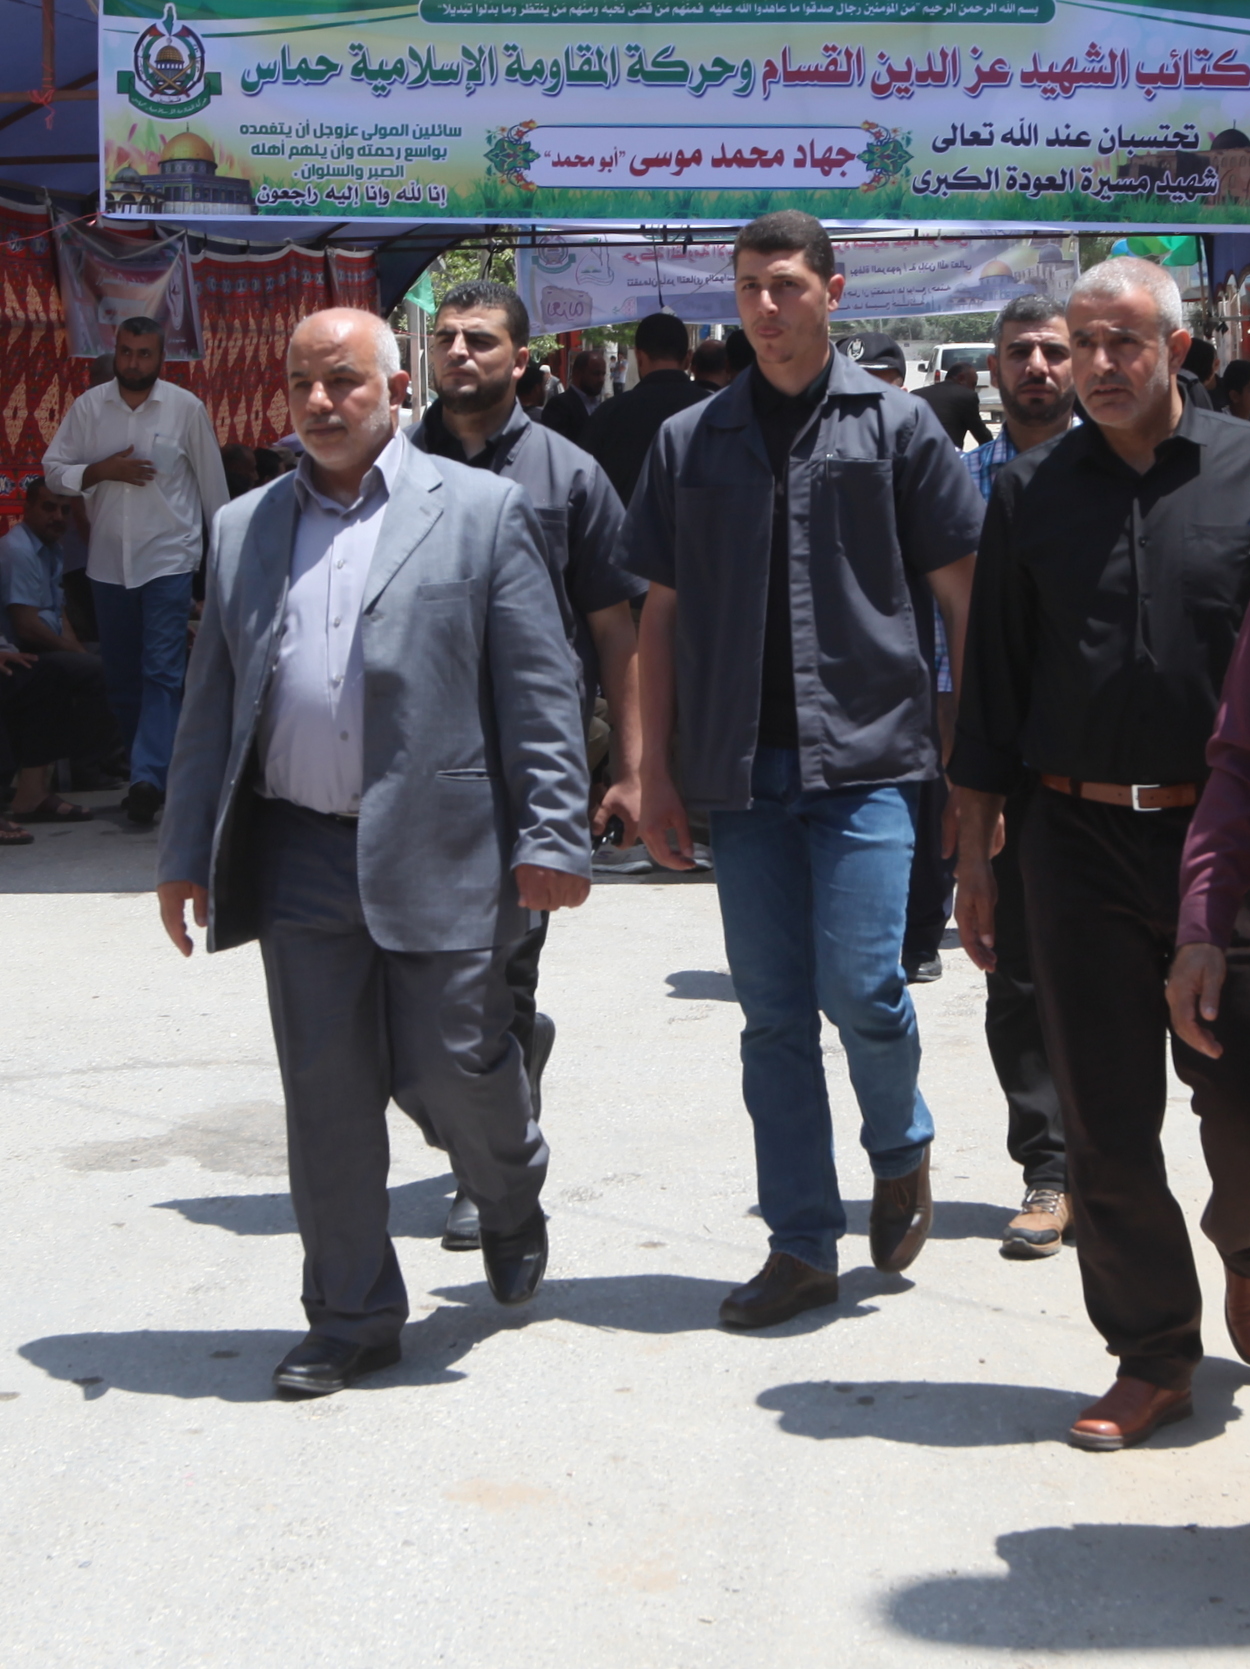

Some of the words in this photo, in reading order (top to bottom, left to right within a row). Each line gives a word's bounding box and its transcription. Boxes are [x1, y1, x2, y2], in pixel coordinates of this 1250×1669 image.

[922, 3, 957, 16] الرحيم
[958, 3, 997, 16] الرحمن
[1000, 2, 1016, 14] الله
[1017, 5, 1039, 17] بسم
[240, 43, 342, 97] حماس
[348, 41, 497, 97] الإسلامية
[501, 42, 619, 96] المقاومة
[623, 42, 755, 96] وحركة
[762, 42, 865, 100] القسام
[870, 45, 961, 99] الدين
[963, 44, 1012, 97] عز
[1019, 41, 1129, 98] الشهيد
[239, 121, 293, 137] يتغمده
[295, 119, 310, 139] أن
[313, 122, 359, 140] عزوجل
[361, 123, 410, 141] المولى
[412, 123, 463, 141] سائلين
[931, 120, 995, 153] تعالى
[1000, 117, 1039, 148] الله
[1044, 121, 1093, 149] عند
[1097, 121, 1201, 157] تحتسبان
[251, 140, 285, 156] أهله
[288, 142, 328, 160] يلهم
[330, 140, 356, 161] وأن
[357, 142, 403, 161] رحمته
[403, 143, 448, 162] بواسع
[711, 142, 785, 169] محمد
[792, 138, 857, 178] جهاد
[367, 164, 405, 180] الصبر
[629, 146, 703, 177] موسى
[395, 181, 423, 203] لله
[912, 165, 1001, 198] الكبرى
[1005, 165, 1075, 198] العودة
[1079, 165, 1150, 202] مسيرة
[1154, 164, 1219, 202] شهيد
[256, 184, 320, 206] راجعون
[324, 184, 360, 207] إليه
[427, 185, 448, 207] إنا
